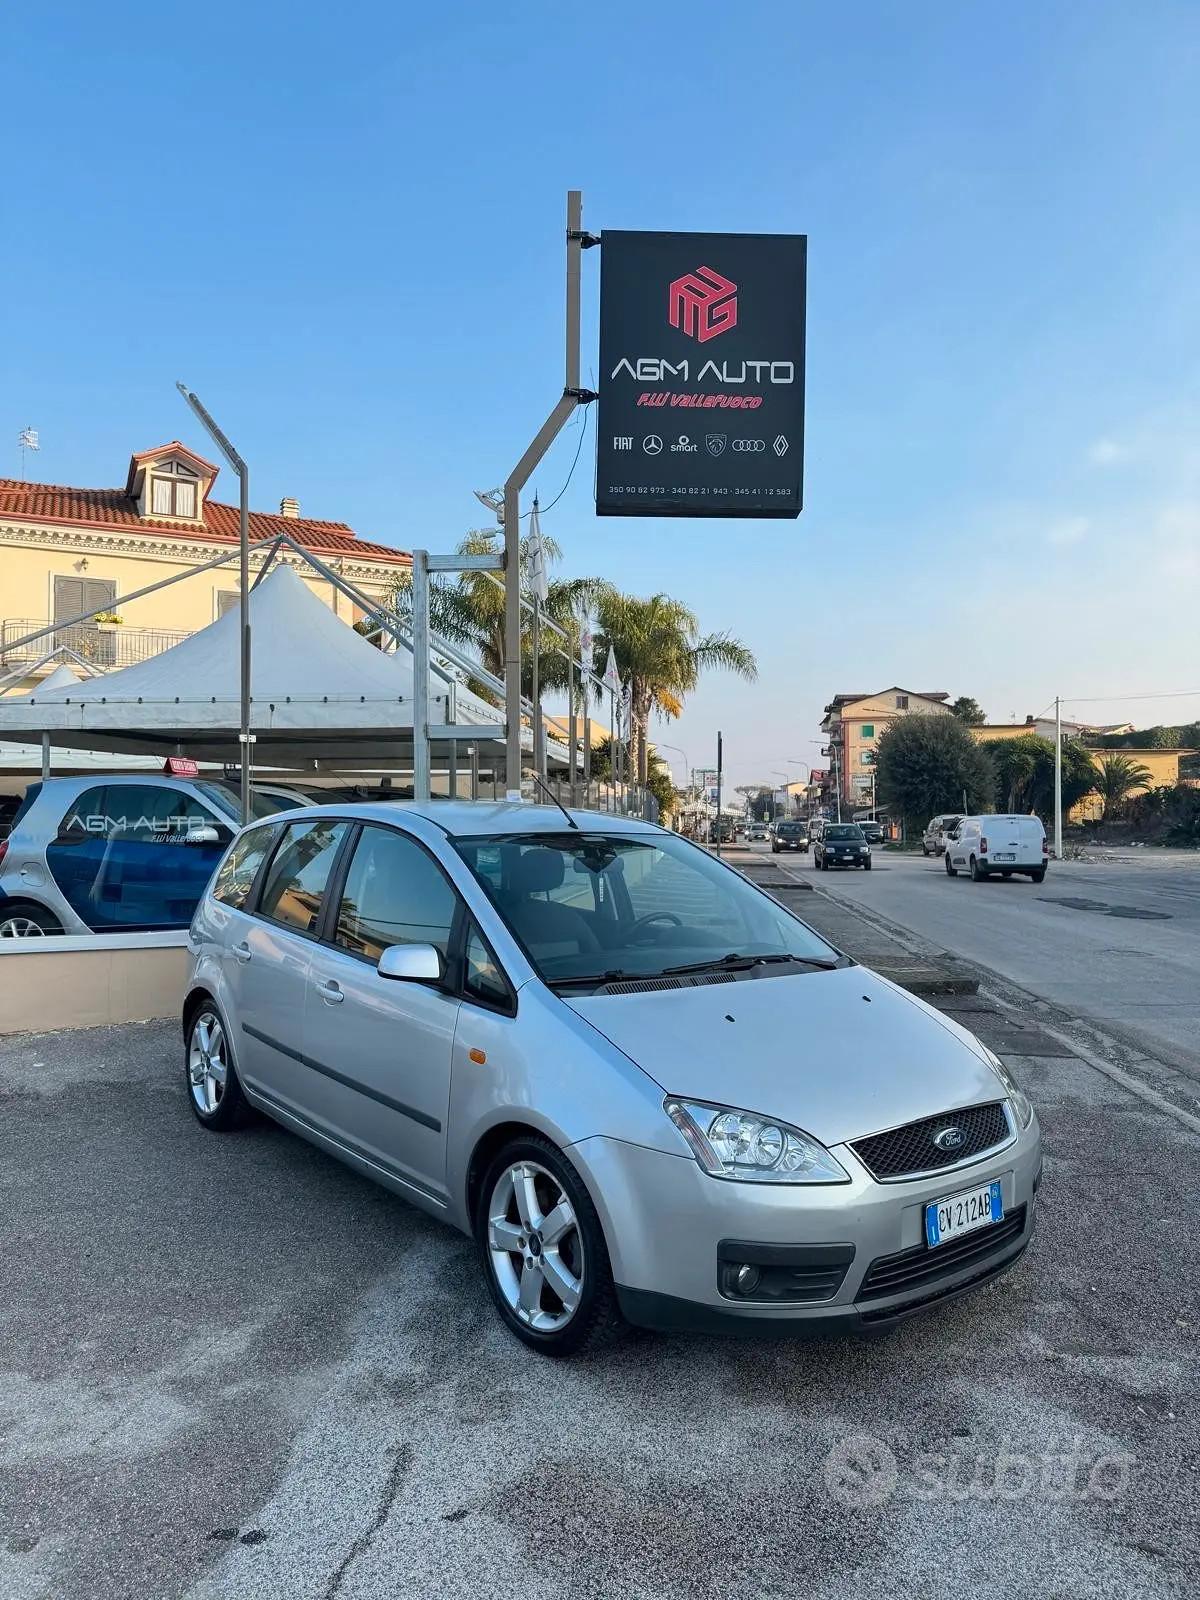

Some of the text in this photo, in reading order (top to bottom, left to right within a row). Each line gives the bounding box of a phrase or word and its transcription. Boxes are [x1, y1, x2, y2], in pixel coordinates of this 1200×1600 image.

[611, 358, 795, 384] AGM AUTO
[670, 394, 763, 409] Vallefuoco
[613, 436, 634, 450] FIAT
[670, 444, 698, 452] smart
[701, 487, 710, 495] 21
[712, 487, 728, 495] 943
[66, 815, 205, 832] AGM AUTO
[945, 1132, 962, 1146] Ford
[938, 1192, 991, 1232] CV 212AB
